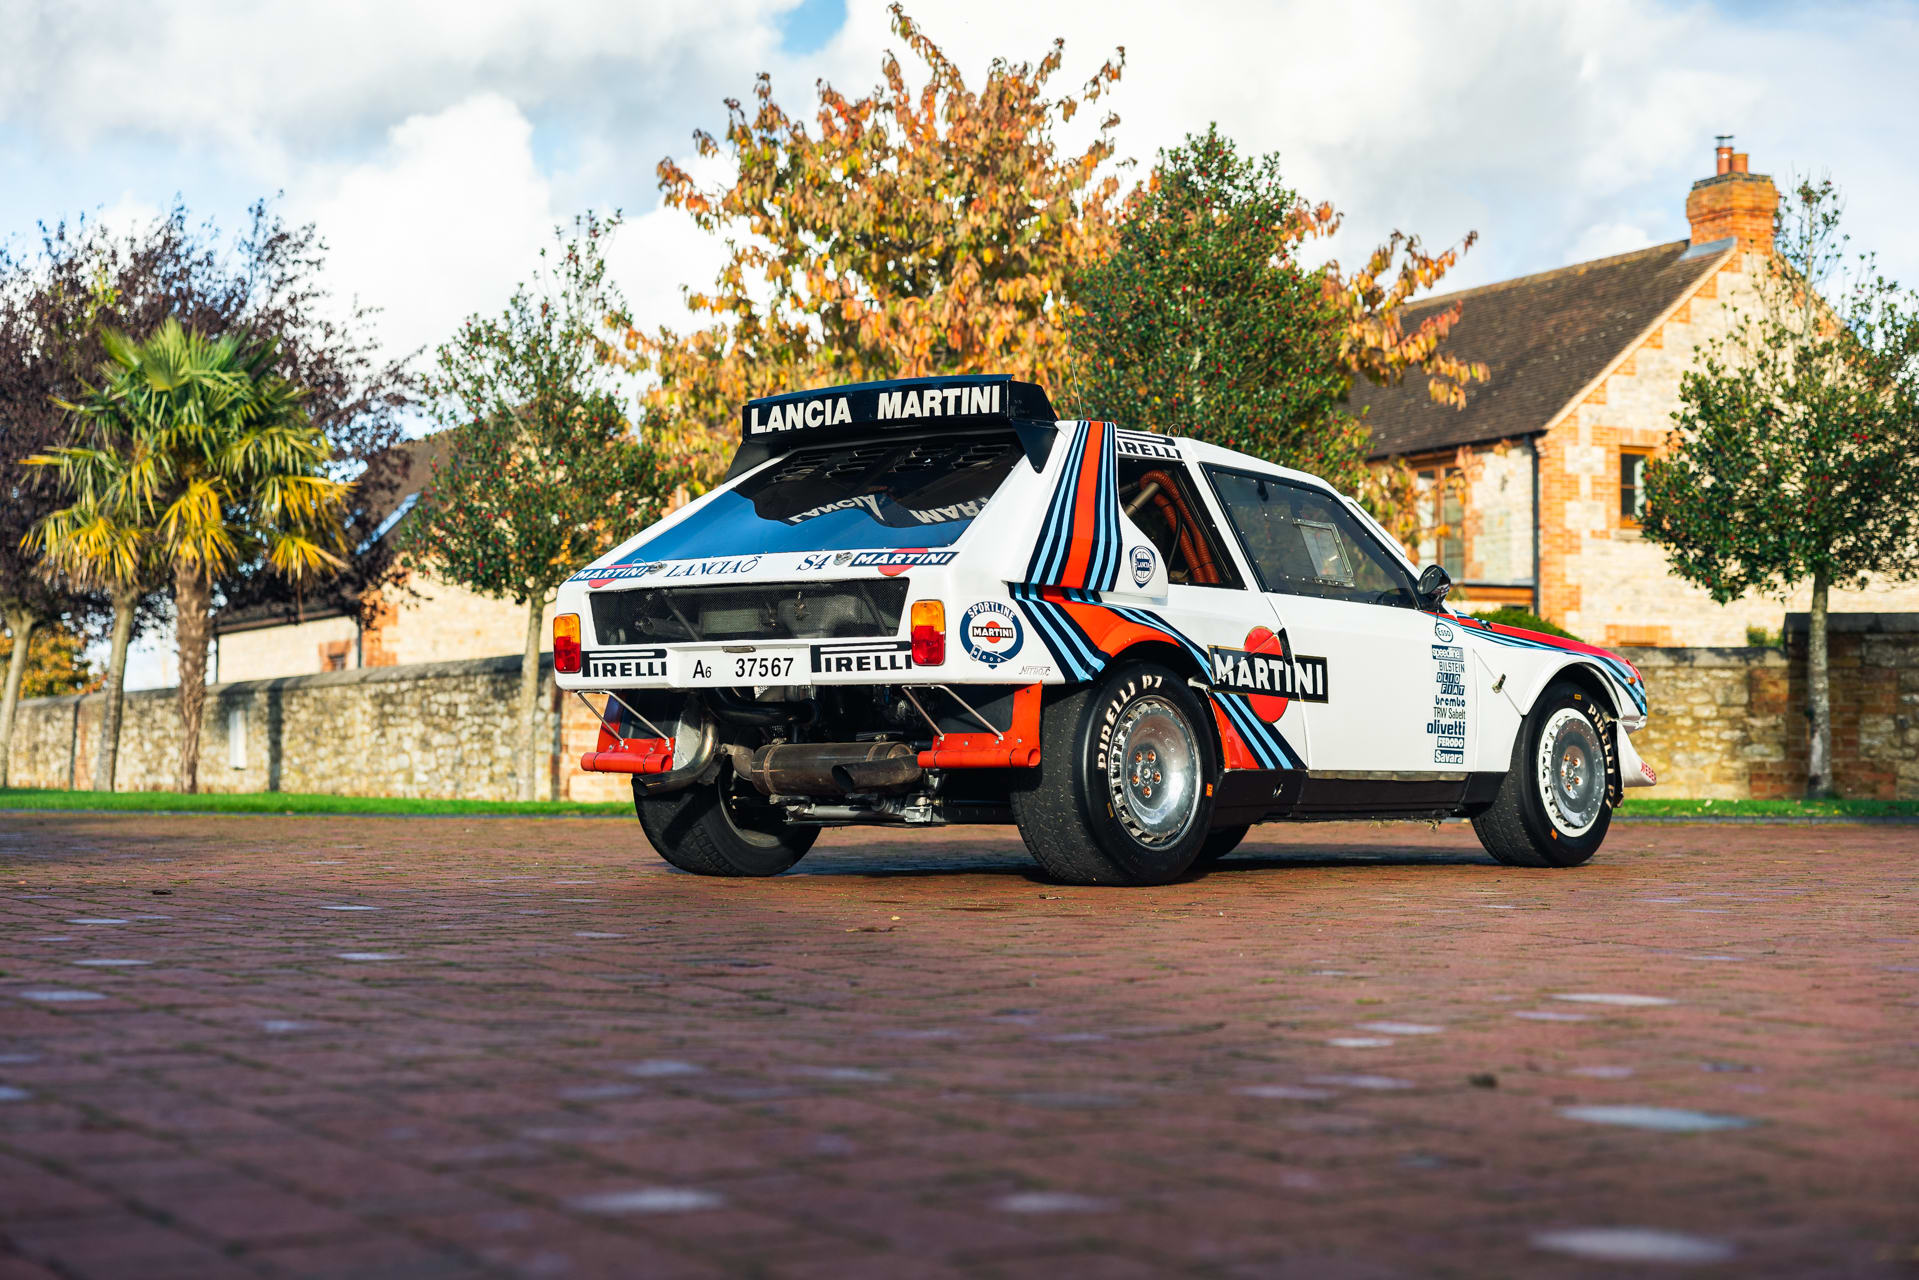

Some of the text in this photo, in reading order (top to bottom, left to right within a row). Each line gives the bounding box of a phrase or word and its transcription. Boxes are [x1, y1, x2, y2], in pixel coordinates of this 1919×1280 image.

[751, 385, 1001, 434] LANCIA MARTINI
[796, 554, 832, 571] S4
[853, 552, 954, 566] MARTINI
[575, 565, 650, 582] MARTINI
[967, 601, 1016, 622] SPORTLINE
[973, 627, 1013, 638] MARTINI
[581, 648, 668, 678] PIRELLI
[810, 641, 912, 673] PIRELLI
[735, 657, 794, 678] 37567
[1213, 653, 1324, 695] MARTINI
[1439, 661, 1465, 673] BILSTEIN
[1436, 672, 1461, 684] OLIO
[1441, 684, 1465, 696] FIAT
[1435, 694, 1466, 707] brembo
[1433, 706, 1466, 720] TRW Sabelt
[1097, 674, 1163, 770] PIRELLI P7
[1427, 719, 1466, 736] olivetti
[1438, 737, 1464, 748] FERODO
[1435, 750, 1464, 764] Savara
